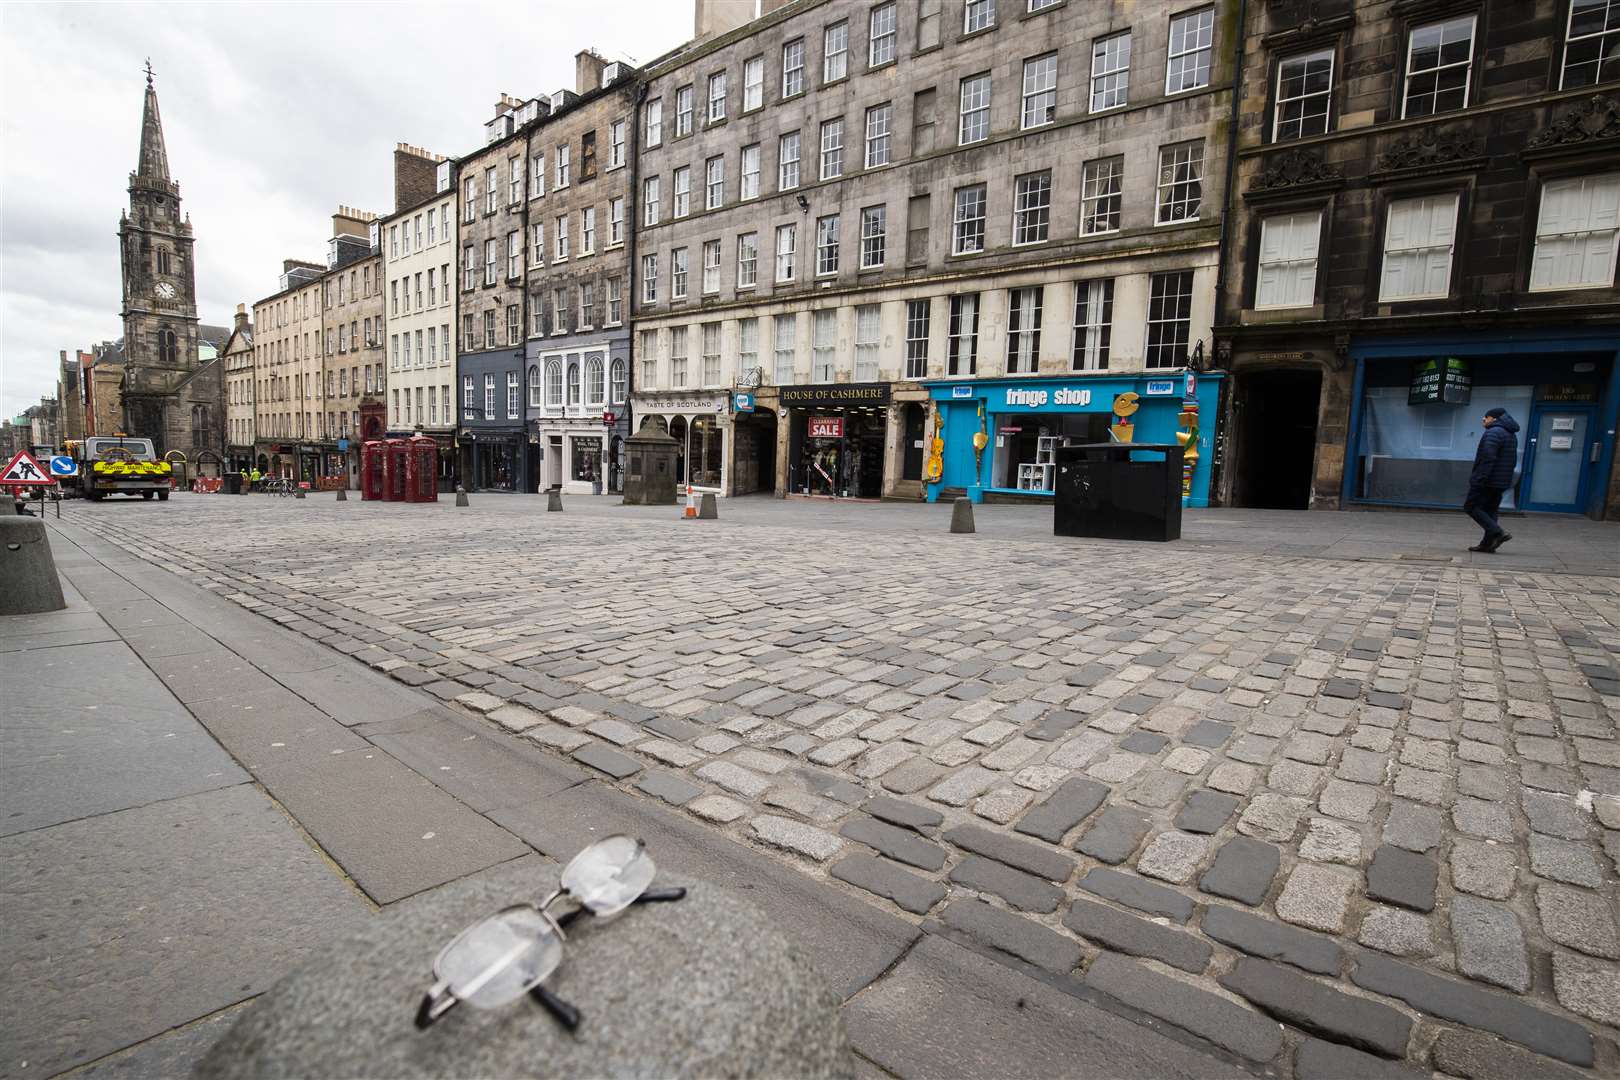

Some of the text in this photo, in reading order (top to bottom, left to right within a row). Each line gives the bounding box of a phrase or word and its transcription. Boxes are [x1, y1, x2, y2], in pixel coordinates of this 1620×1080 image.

[1149, 382, 1171, 392] fringe
[783, 389, 883, 400] HOUSE OF CASHMERE
[1006, 387, 1091, 408] fringe shop
[812, 424, 839, 436] SALE
